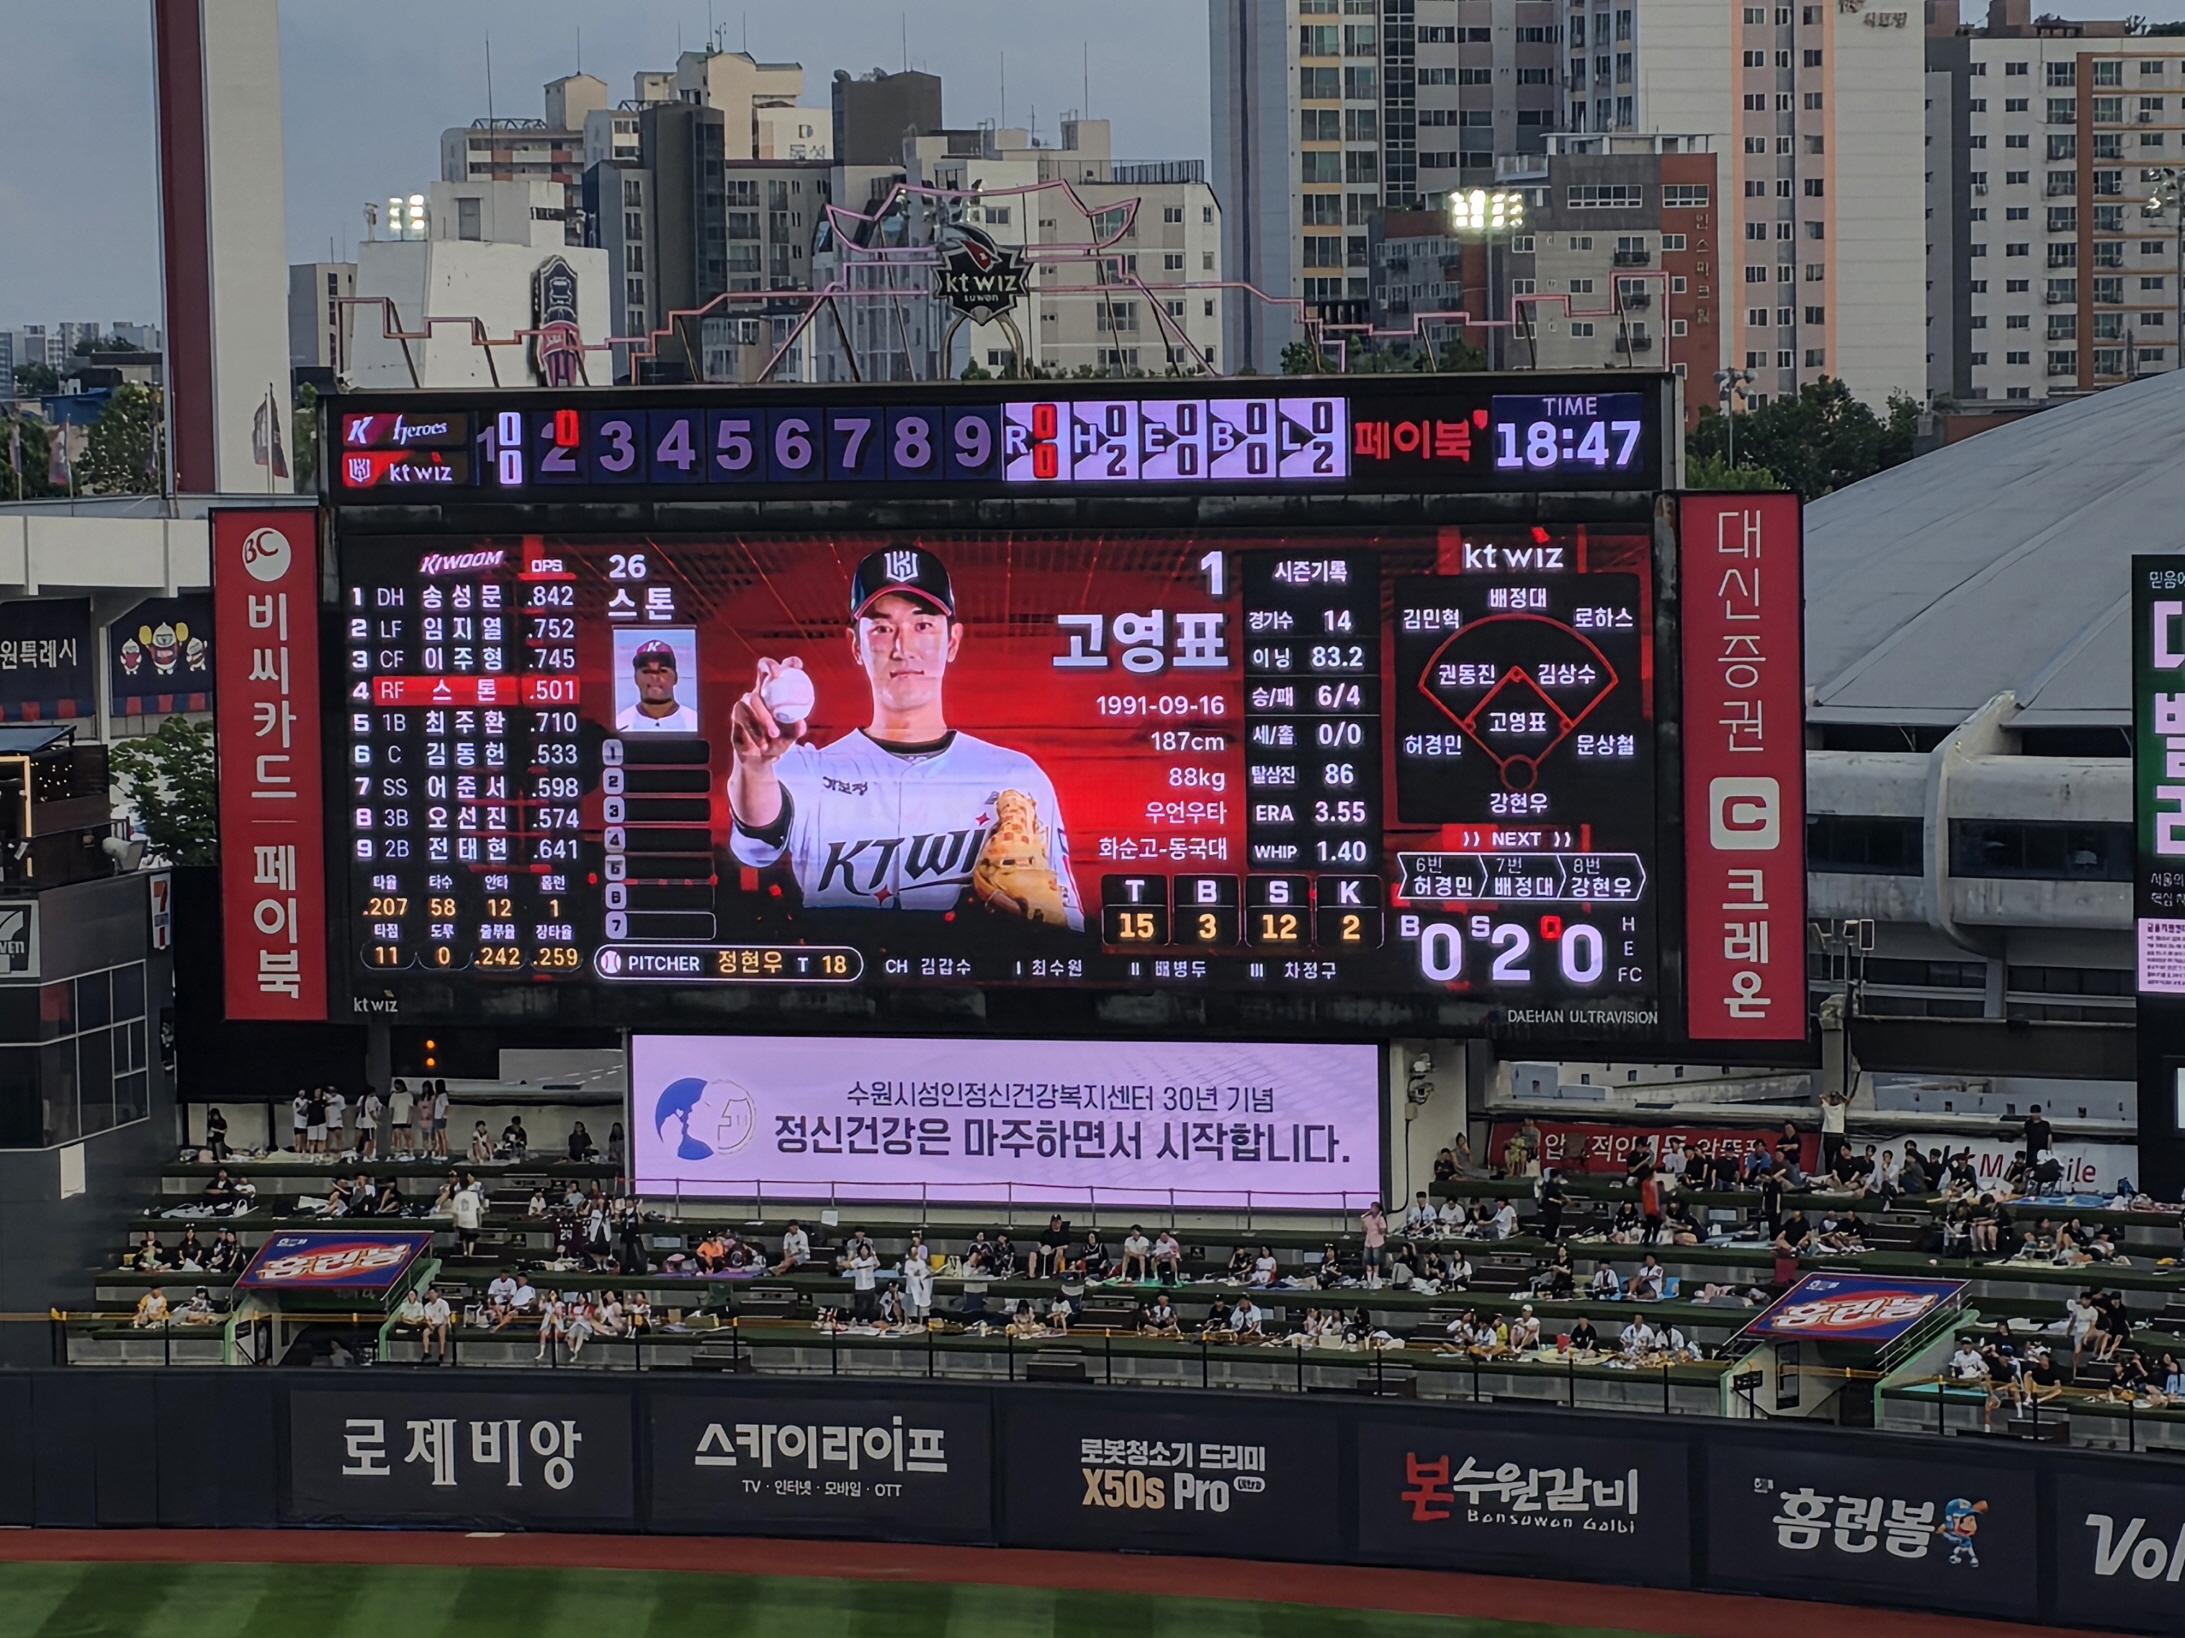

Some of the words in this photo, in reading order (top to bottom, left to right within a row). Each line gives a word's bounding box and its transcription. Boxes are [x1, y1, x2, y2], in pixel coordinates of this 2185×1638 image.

[946, 273, 968, 292] kt
[1543, 397, 1597, 416] TIME
[1355, 419, 1471, 461] 페이북
[1498, 421, 1641, 467] 18:47
[389, 464, 409, 481] kt
[245, 530, 280, 564] BC
[1464, 544, 1497, 568] kt
[1503, 547, 1563, 568] wiz
[531, 560, 562, 572] OPS
[609, 555, 646, 578] 26
[1201, 551, 1223, 595] 1
[1274, 560, 1347, 583] 시즌기록
[378, 589, 403, 606] DH
[528, 586, 573, 605] .842
[608, 588, 674, 620] 스톤
[1489, 588, 1547, 608] 배정대
[381, 622, 401, 637] LF
[528, 619, 574, 638] .752
[1249, 611, 1293, 630] 경기수
[1324, 610, 1351, 631] 14
[1404, 609, 1460, 629] 김민혁
[1575, 608, 1633, 627] 로하스
[1718, 509, 1766, 752] 대신증권
[1052, 609, 1229, 673] 고영표
[380, 651, 404, 667] CF
[529, 649, 575, 668] .745
[1253, 648, 1290, 668] 이닝
[1312, 647, 1364, 667] 83.2
[1439, 665, 1495, 684] 권동진
[1538, 664, 1595, 684] 김상수
[249, 593, 297, 799] 비씨카드
[381, 682, 404, 698] RF
[530, 681, 573, 699] .501
[1252, 686, 1293, 707] 승/패
[1319, 684, 1360, 708] 6/4
[1097, 696, 1225, 715] 1991-09-16
[383, 715, 405, 730] 1B
[531, 713, 576, 732] .710
[1489, 712, 1546, 732] 고영표
[1151, 732, 1225, 750] 187cm
[1319, 722, 1361, 746] 0/0
[388, 746, 401, 762] C
[531, 745, 577, 763] .533
[1405, 735, 1461, 755] 허경민
[1577, 735, 1634, 755] 문상철
[1169, 768, 1225, 791] 88kg
[1252, 766, 1295, 785] 탈삼진
[1325, 764, 1353, 784] 86
[384, 778, 408, 796] SS
[532, 778, 578, 797] .598
[1146, 801, 1227, 824] 우언우타
[1256, 805, 1294, 821] ERA
[1315, 801, 1365, 822] 3.55
[1491, 793, 1547, 813] 강현우
[385, 810, 408, 825] 3B
[533, 809, 579, 827] .574
[385, 840, 409, 857] 2B
[534, 840, 577, 858] .641
[1099, 837, 1227, 860] 화순고-동국대
[1492, 832, 1541, 846] NEXT
[1255, 845, 1297, 858] WHIP
[1317, 841, 1366, 861] 1.40
[1416, 858, 1442, 874] 6번
[1496, 858, 1522, 873] 7번
[1574, 858, 1600, 874] 8번
[429, 875, 452, 889] 타수
[485, 875, 508, 889] 안타
[1414, 877, 1472, 897] 허경민
[1494, 878, 1553, 896] 배정대
[1571, 878, 1631, 897] 강현우
[363, 899, 407, 916] .207
[430, 899, 456, 916] 58
[488, 899, 511, 917] 12
[551, 900, 559, 917] 1
[254, 845, 301, 998] 페이북
[1119, 913, 1154, 939] 15
[1199, 914, 1216, 939] 3
[1263, 915, 1297, 939] 12
[1342, 915, 1360, 939] 2
[1401, 916, 1419, 936] B
[1421, 923, 1461, 981] 0
[1471, 916, 1490, 936] S
[1491, 924, 1530, 980] 2
[1561, 924, 1602, 982] 0
[1722, 869, 1771, 1018] 크레온
[375, 947, 398, 964] 11
[438, 947, 450, 965] 0
[474, 948, 520, 965] .242
[532, 948, 578, 966] .259
[629, 956, 700, 971] PITCHER
[719, 951, 782, 973] 정현우
[823, 956, 846, 973] 18
[886, 960, 908, 973] CH
[1032, 959, 1082, 976] 최수원
[1285, 961, 1336, 979] 차정구
[1618, 968, 1642, 982] FC
[354, 998, 367, 1012] kt
[371, 999, 397, 1012] wiz
[1508, 1010, 1564, 1023] DAEHAN
[1570, 1011, 1657, 1024] ULTRAVISION
[848, 1081, 1154, 1112] 수원시성인정신건강복지센터
[1164, 1086, 1218, 1112] 30년
[1227, 1086, 1274, 1112] 기념
[775, 1115, 951, 1156] 정신건강은
[964, 1118, 1142, 1160] 마주하면서
[1156, 1122, 1350, 1163] 시작합니다.
[695, 1416, 947, 1472] 스카이라이프
[342, 1419, 582, 1490] 로제비앙
[1081, 1439, 1193, 1467] 로봇청소기
[1200, 1444, 1265, 1471] 드리미
[742, 1480, 761, 1493] TV
[775, 1480, 811, 1495] 인터넷
[825, 1481, 861, 1497] 모바일
[875, 1484, 902, 1497] OTT
[1082, 1468, 1164, 1509] X50s
[1174, 1472, 1229, 1512] Pro
[1773, 1488, 1935, 1558] 홈런볼
